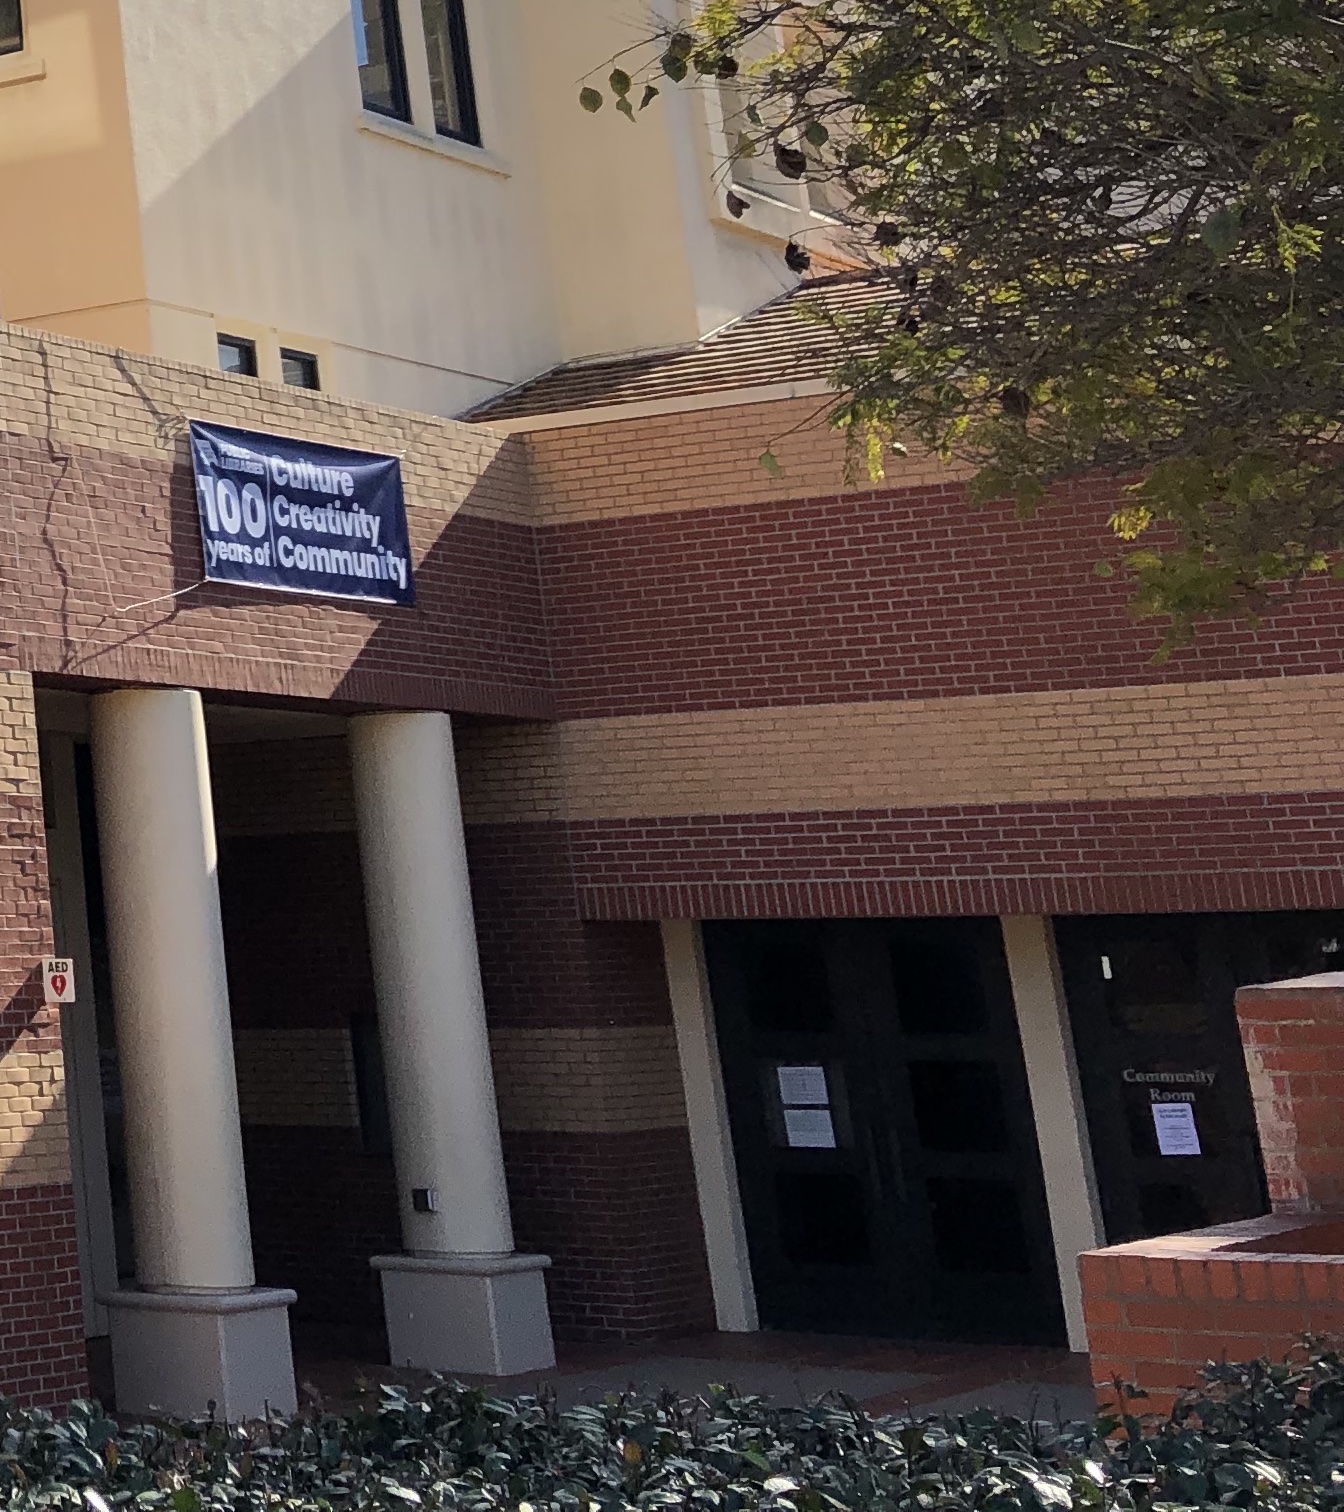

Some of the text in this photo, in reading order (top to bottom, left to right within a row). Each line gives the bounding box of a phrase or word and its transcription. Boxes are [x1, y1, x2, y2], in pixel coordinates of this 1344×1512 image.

[272, 455, 355, 497] Culture
[196, 475, 266, 538] 100
[273, 495, 381, 547] Creativity
[206, 539, 271, 567] years of
[277, 535, 407, 590] Community
[48, 961, 69, 973] AED
[1123, 1068, 1216, 1087] Community
[1150, 1088, 1197, 1102] Room
